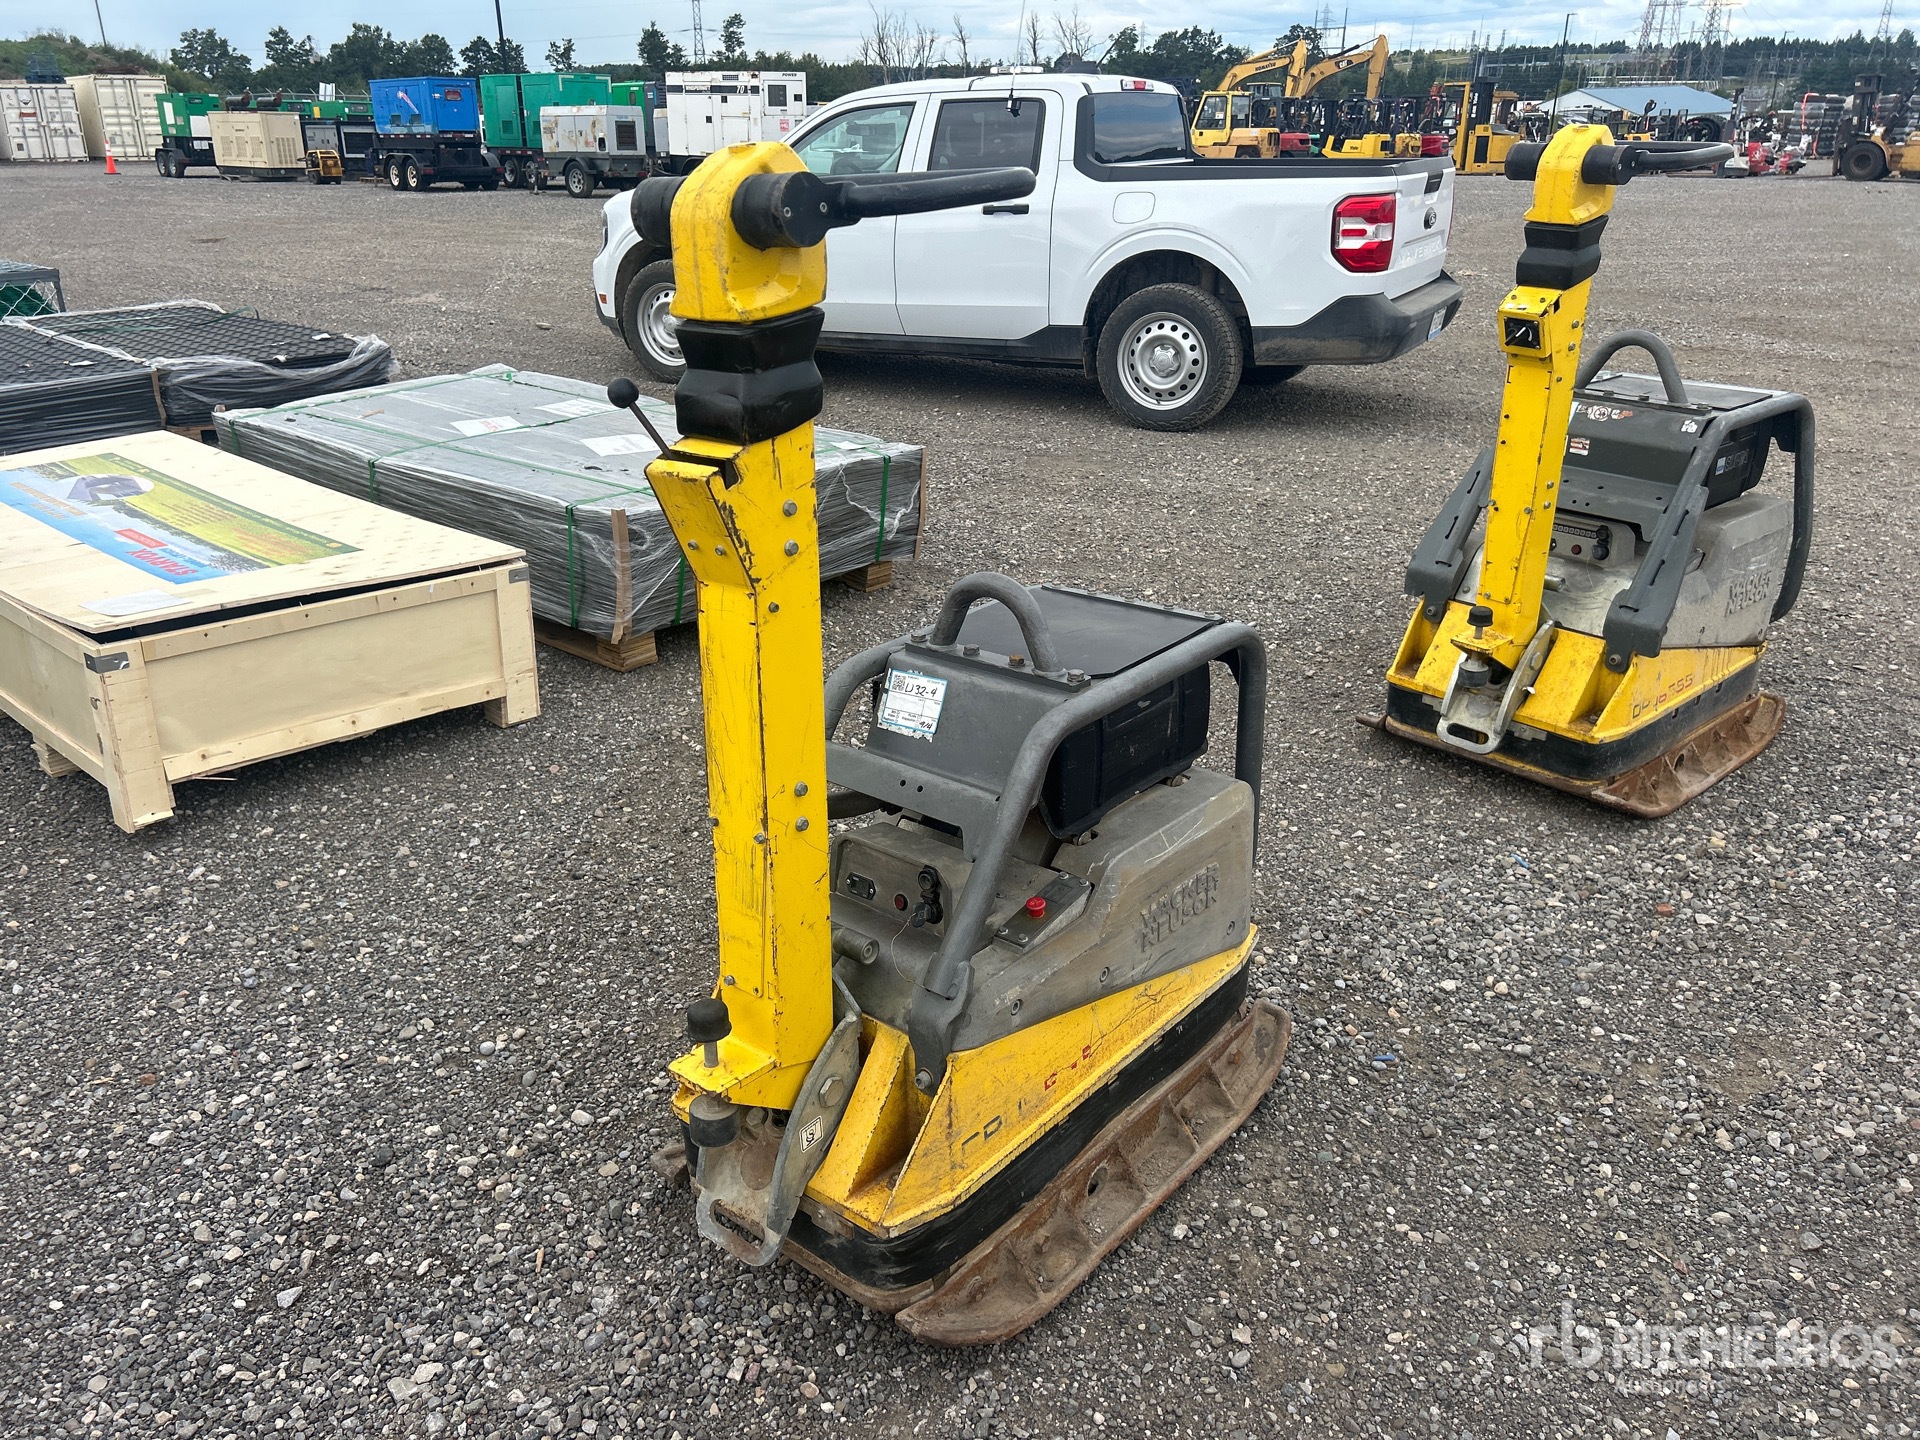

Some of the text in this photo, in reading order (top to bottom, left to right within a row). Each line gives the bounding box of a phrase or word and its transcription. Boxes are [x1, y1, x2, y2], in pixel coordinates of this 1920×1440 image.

[1339, 60, 1348, 69] CAT
[736, 85, 745, 94] 70
[1397, 241, 1442, 265] MAVERICK
